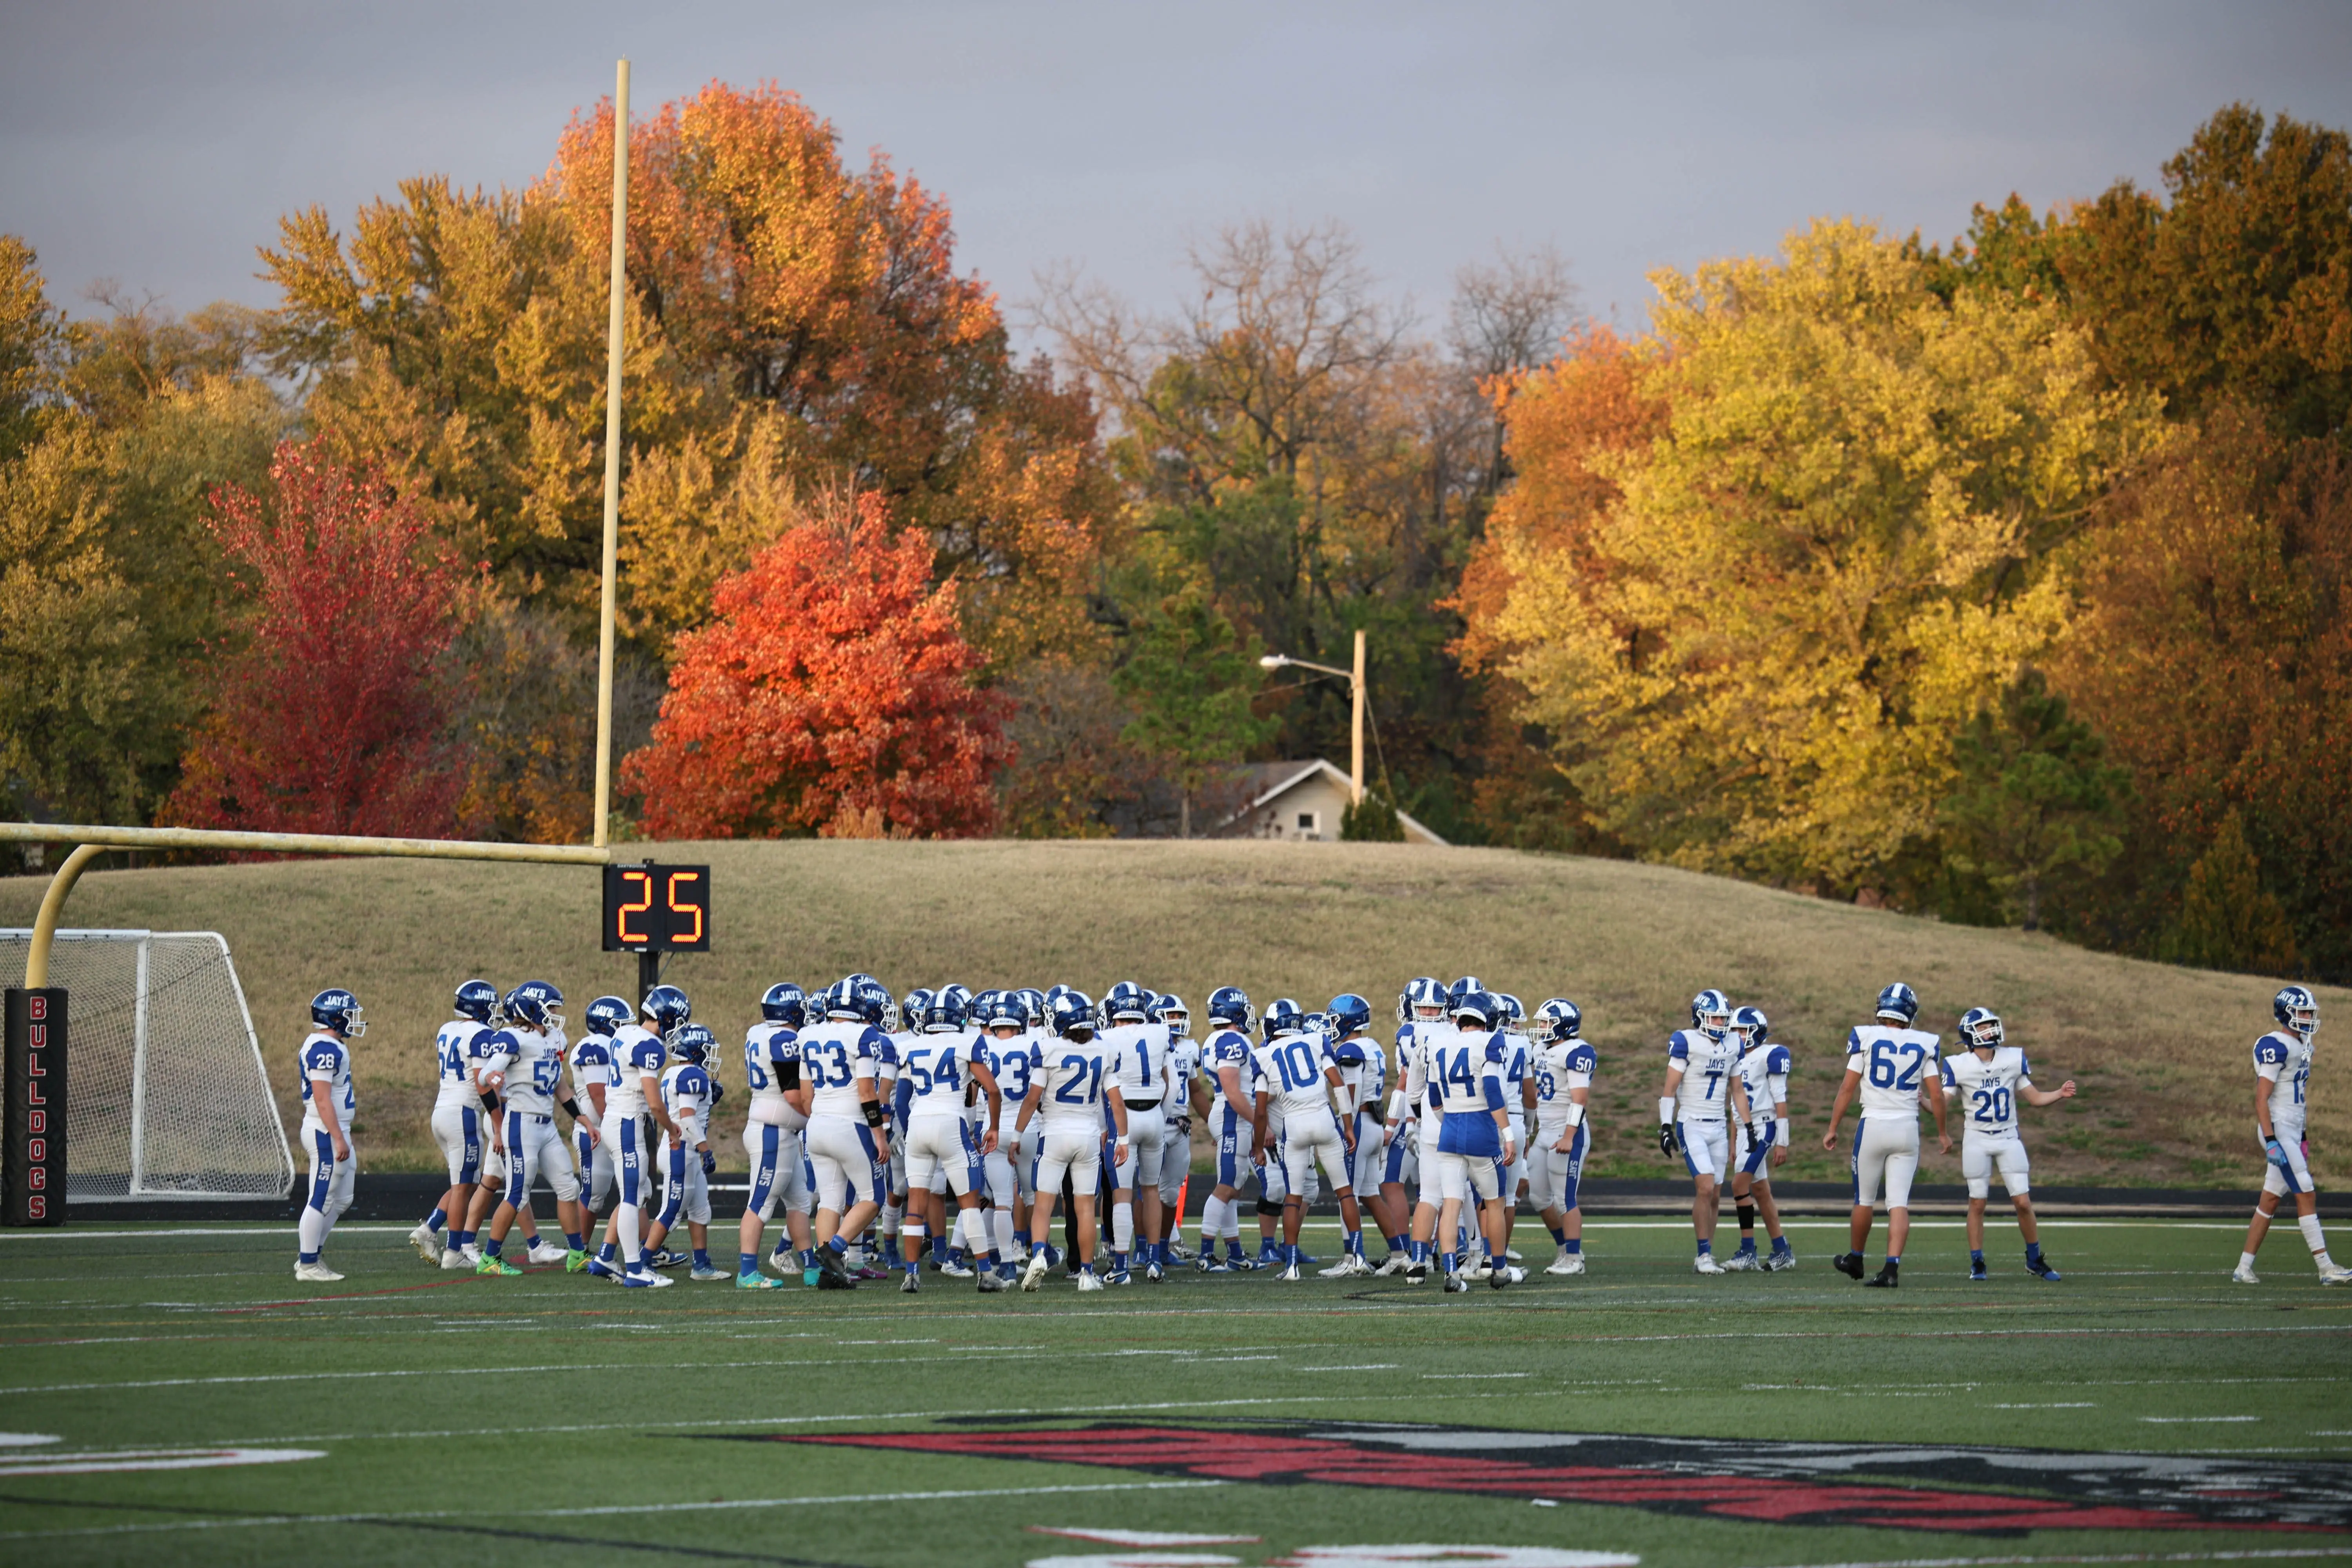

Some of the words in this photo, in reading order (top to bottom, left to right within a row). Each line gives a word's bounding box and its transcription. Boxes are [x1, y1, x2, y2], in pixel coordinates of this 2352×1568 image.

[618, 872, 701, 942] 25
[324, 995, 350, 1007] JAYS
[474, 989, 495, 1002] JAYS
[522, 987, 546, 999] JAYS
[779, 990, 802, 1002] JAYS
[866, 989, 886, 1002] JAYS
[903, 993, 922, 1007] JAYS
[1693, 994, 1710, 1007] JAYS
[2277, 990, 2297, 1004] JAYS
[592, 1005, 615, 1018] JAYS
[668, 997, 690, 1016] JAYS
[684, 1030, 708, 1042] JAYS
[543, 1048, 557, 1060] JAYS
[1224, 1043, 1243, 1060] 25
[1669, 1042, 1675, 1055] 7
[2262, 1048, 2276, 1063] 13
[316, 1053, 335, 1069] 28
[437, 1034, 466, 1082] 64
[644, 1053, 659, 1070] 15
[802, 1040, 853, 1089] 63
[1135, 1038, 1151, 1087] 1
[1175, 1058, 1187, 1070] AYS
[1271, 1041, 1319, 1093] 10
[1575, 1056, 1592, 1072] 50
[1706, 1059, 1726, 1069] JAYS
[1780, 1058, 1790, 1073] 16
[1869, 1039, 1926, 1091] 62
[533, 1060, 561, 1096] 52
[907, 1047, 960, 1096] 54
[1055, 1054, 1102, 1104] 21
[1436, 1047, 1475, 1098] 14
[1507, 1047, 1526, 1095] 4
[687, 1078, 701, 1094] 17
[1705, 1071, 1723, 1100] 7
[1980, 1077, 2000, 1089] JAYS
[29, 996, 47, 1219] BULLDOGS
[1972, 1087, 2010, 1123] 20
[466, 1143, 478, 1163] JAYS
[1223, 1135, 1235, 1154] JAYS
[513, 1154, 523, 1175] JAYS
[624, 1151, 637, 1169] JAYS
[318, 1161, 332, 1181] JAYS
[758, 1166, 774, 1187] JAYS
[1568, 1160, 1578, 1180] JAYS
[670, 1180, 682, 1201] JAYS
